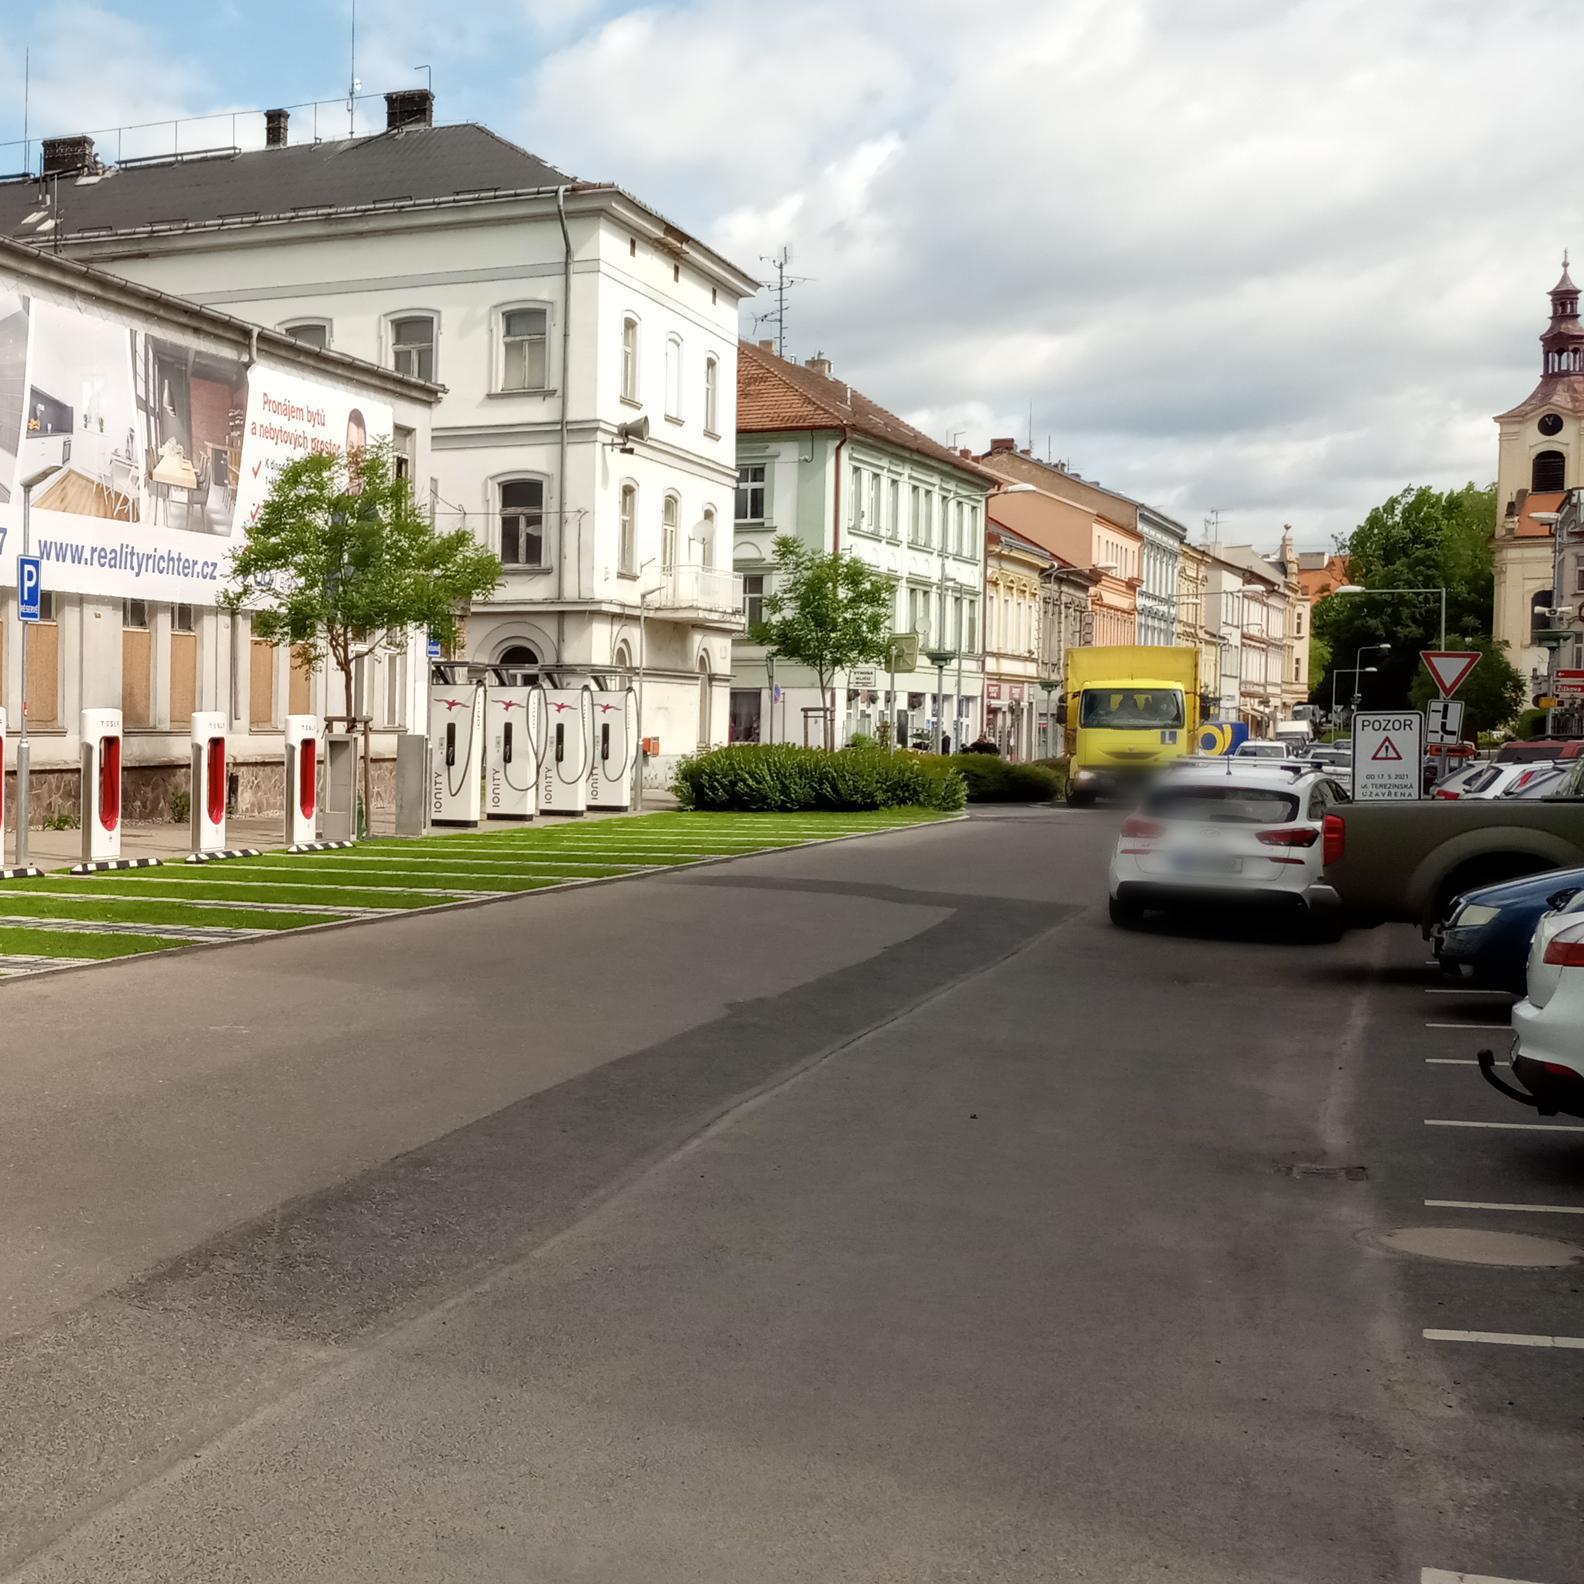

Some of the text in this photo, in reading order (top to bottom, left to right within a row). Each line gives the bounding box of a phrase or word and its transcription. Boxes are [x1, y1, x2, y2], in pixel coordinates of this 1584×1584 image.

[262, 392, 326, 428] Pronájem bytů
[251, 421, 257, 435] a
[259, 422, 308, 450] nebytových
[38, 539, 218, 580] www.realityrichter.cz
[24, 564, 37, 600] P
[1361, 719, 1413, 732] POZOR
[434, 772, 443, 813] IONITY
[492, 768, 500, 808] IONITY
[544, 767, 553, 804] IONITY
[590, 765, 599, 800] IONITY
[1361, 790, 1413, 798] UZAVŘENA
